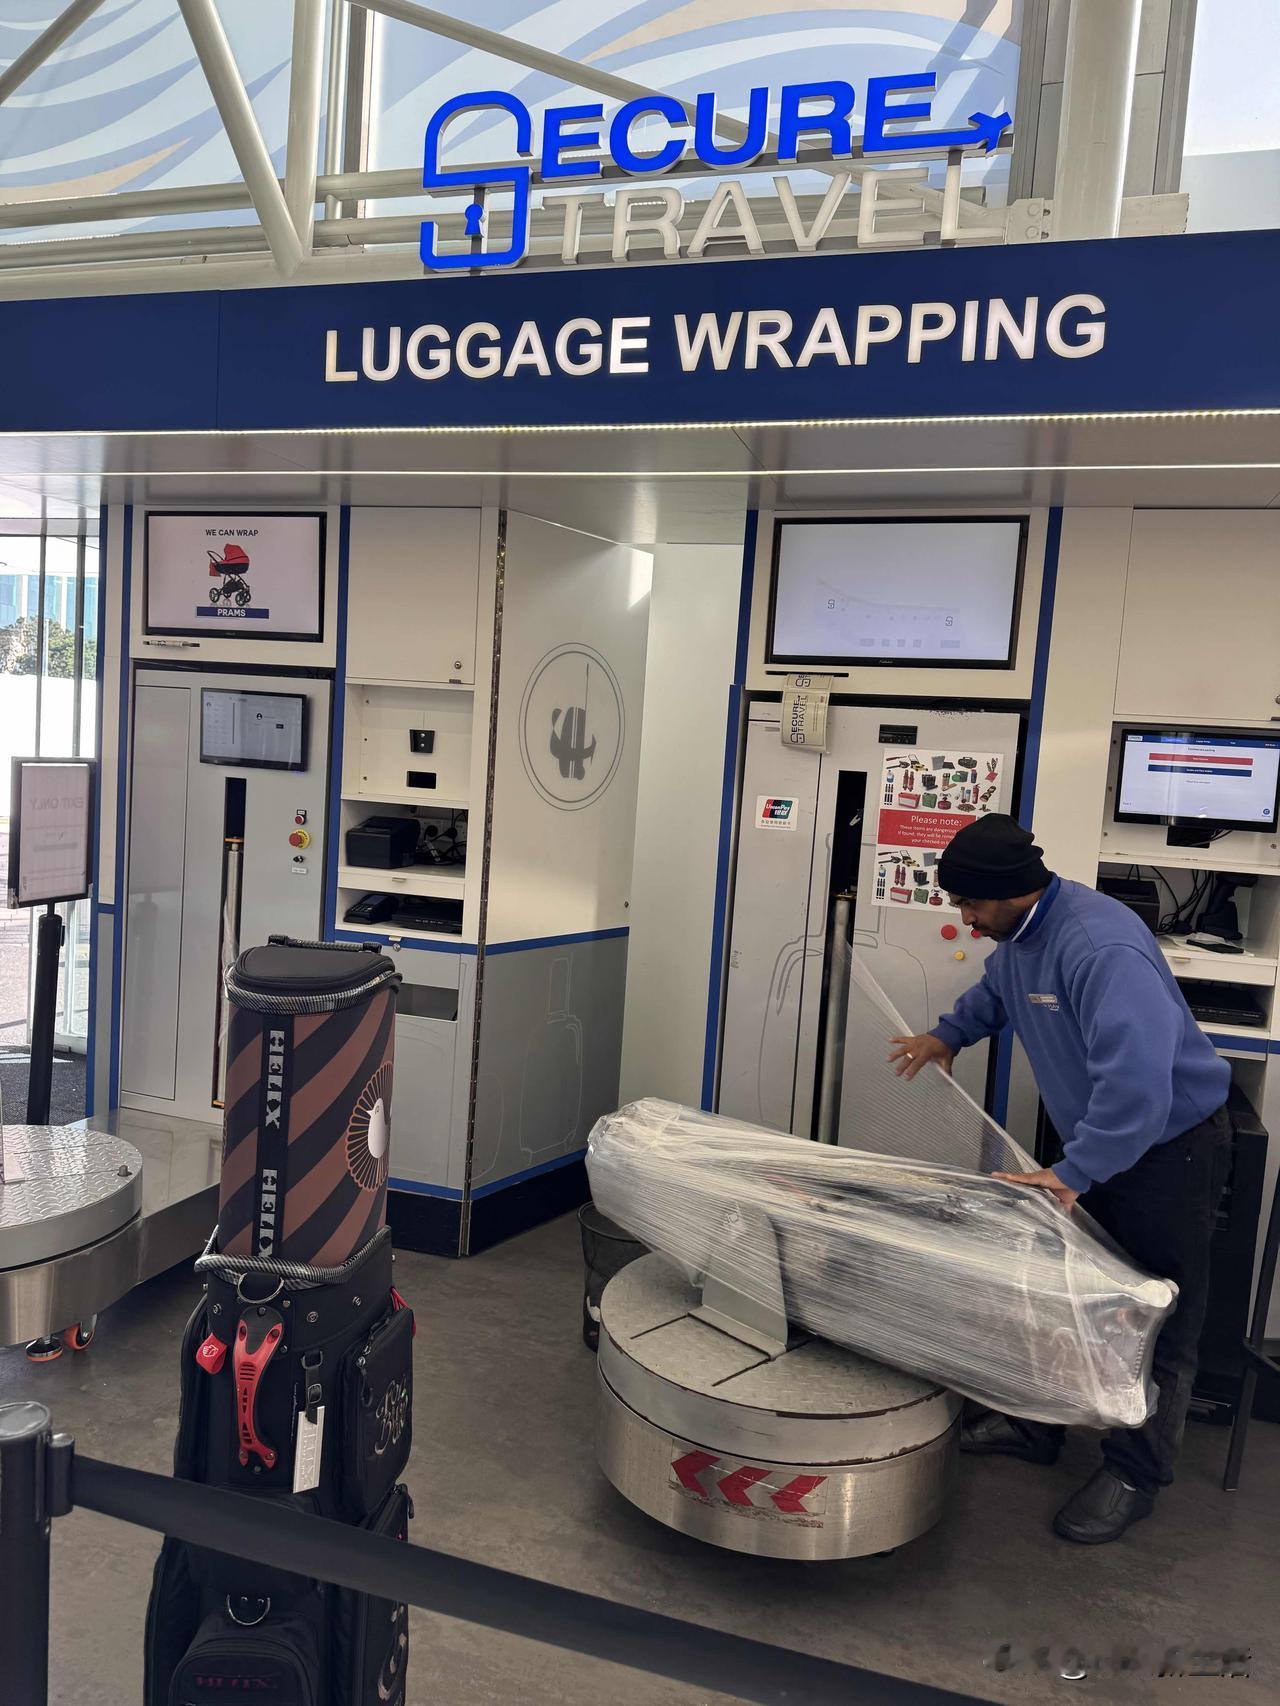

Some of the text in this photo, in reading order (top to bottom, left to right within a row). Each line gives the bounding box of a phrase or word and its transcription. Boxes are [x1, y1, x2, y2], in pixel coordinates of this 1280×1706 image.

[420, 72, 938, 268] SECURE
[541, 152, 1007, 265] TRAVEL
[325, 293, 1107, 382] LUGGAGE WRAPPING
[218, 529, 235, 537] CAN
[236, 529, 259, 537] WRAP
[217, 608, 246, 617] PRAMS
[798, 695, 807, 731] TRAVEL
[911, 815, 962, 827] Please note:
